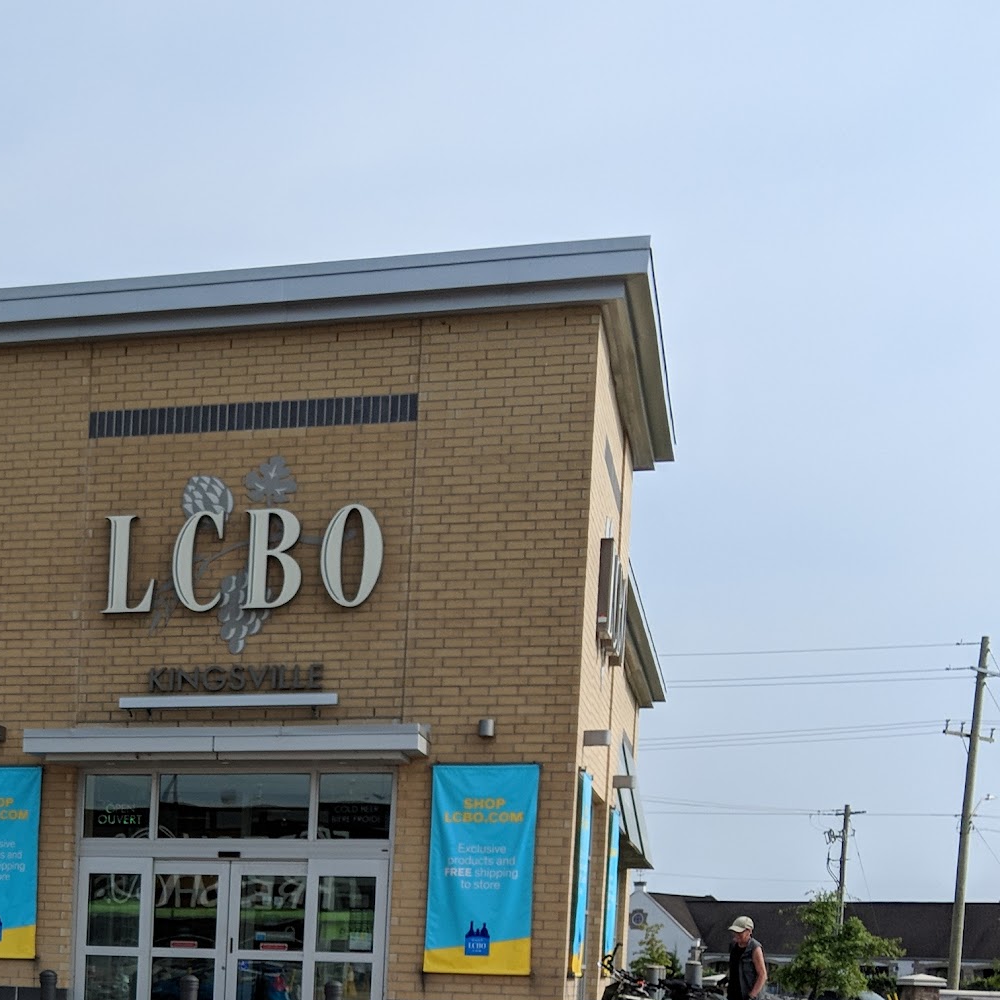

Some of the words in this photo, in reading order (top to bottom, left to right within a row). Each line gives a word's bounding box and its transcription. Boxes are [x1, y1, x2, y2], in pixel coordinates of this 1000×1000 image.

[101, 504, 384, 613] LCBO
[149, 663, 324, 692] KINGSVILLE
[105, 803, 136, 814] OPEN
[463, 798, 506, 809] SHOP
[97, 814, 143, 825] OUVERT
[443, 811, 524, 824] LCBO.COM
[457, 843, 507, 854] Exclusive
[7, 851, 23, 859] and
[447, 856, 494, 867] products
[496, 855, 515, 866] and
[444, 867, 472, 877] FREE
[474, 868, 519, 880] shipping
[460, 879, 472, 889] to
[473, 880, 500, 889] store
